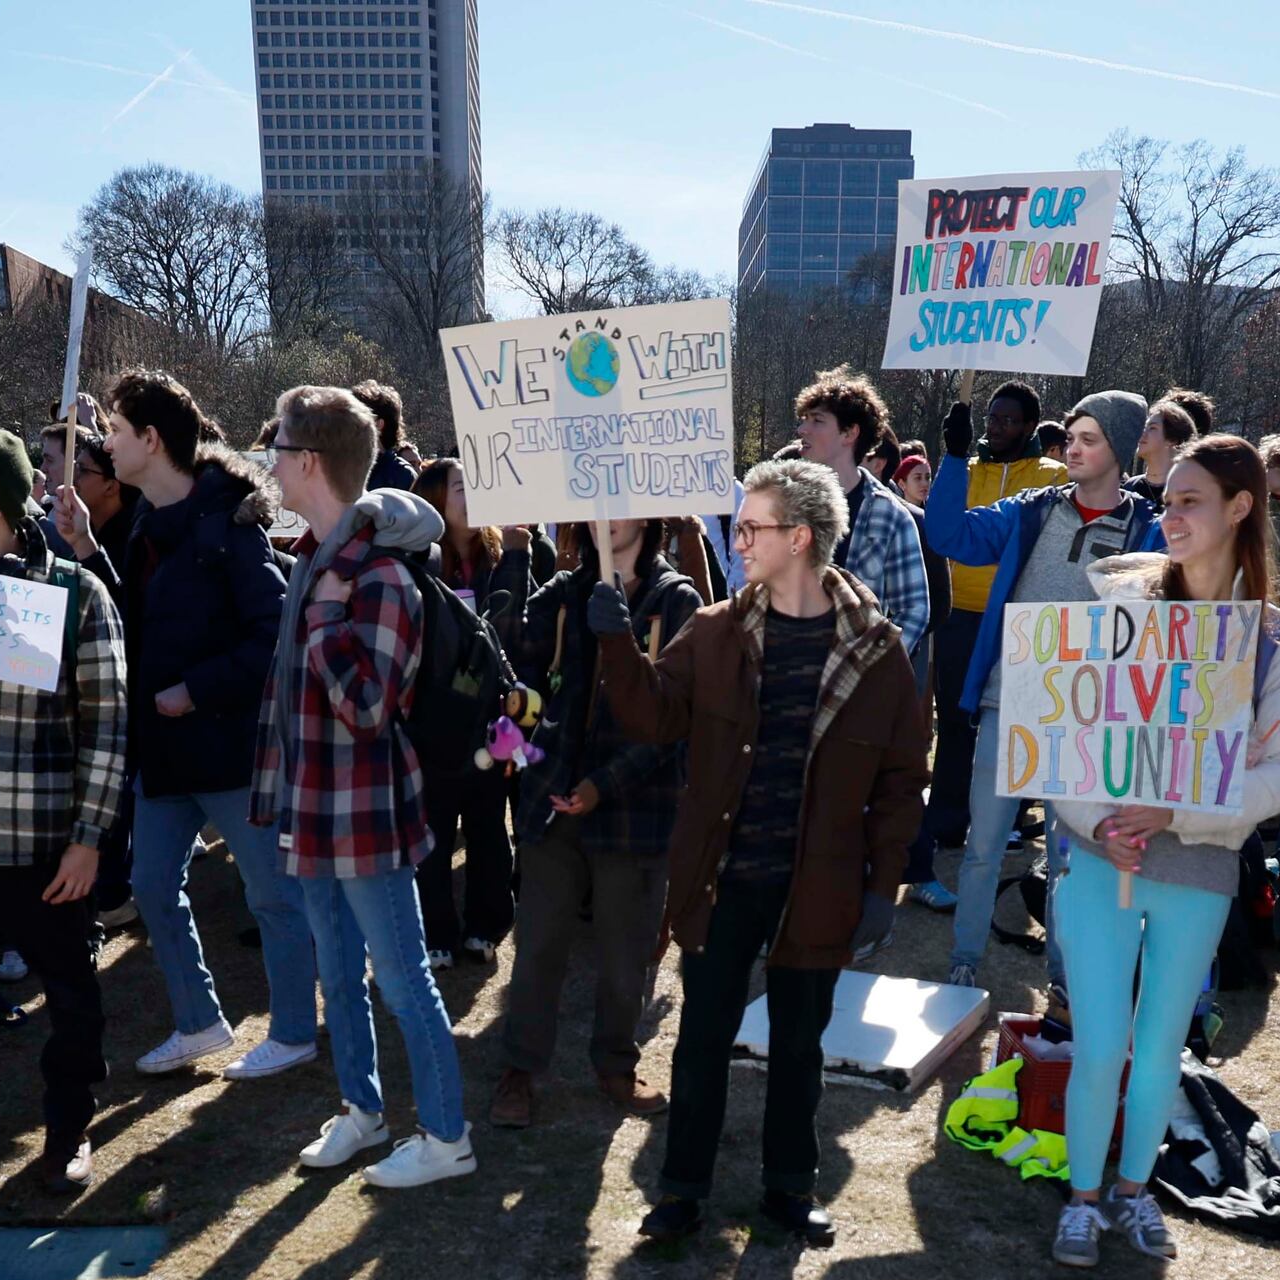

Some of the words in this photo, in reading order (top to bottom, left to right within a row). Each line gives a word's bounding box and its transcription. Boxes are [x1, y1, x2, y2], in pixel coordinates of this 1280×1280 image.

[925, 187, 1030, 239] PROTECT
[1029, 186, 1086, 228] OUR
[900, 240, 1101, 295] INTERNATIONAL
[910, 298, 1051, 351] STUDENTS!
[452, 339, 549, 410] WE
[551, 316, 622, 361] STAND
[628, 331, 726, 380] WITH
[462, 432, 523, 490] OUR
[512, 408, 725, 452] INTERNATIONAL
[569, 450, 730, 498] STUDENTS
[21, 608, 52, 625] ITS
[1009, 604, 1260, 664] SOLIDARITY
[1038, 663, 1218, 726] SOLVES
[1008, 725, 1244, 805] DISUNITY
